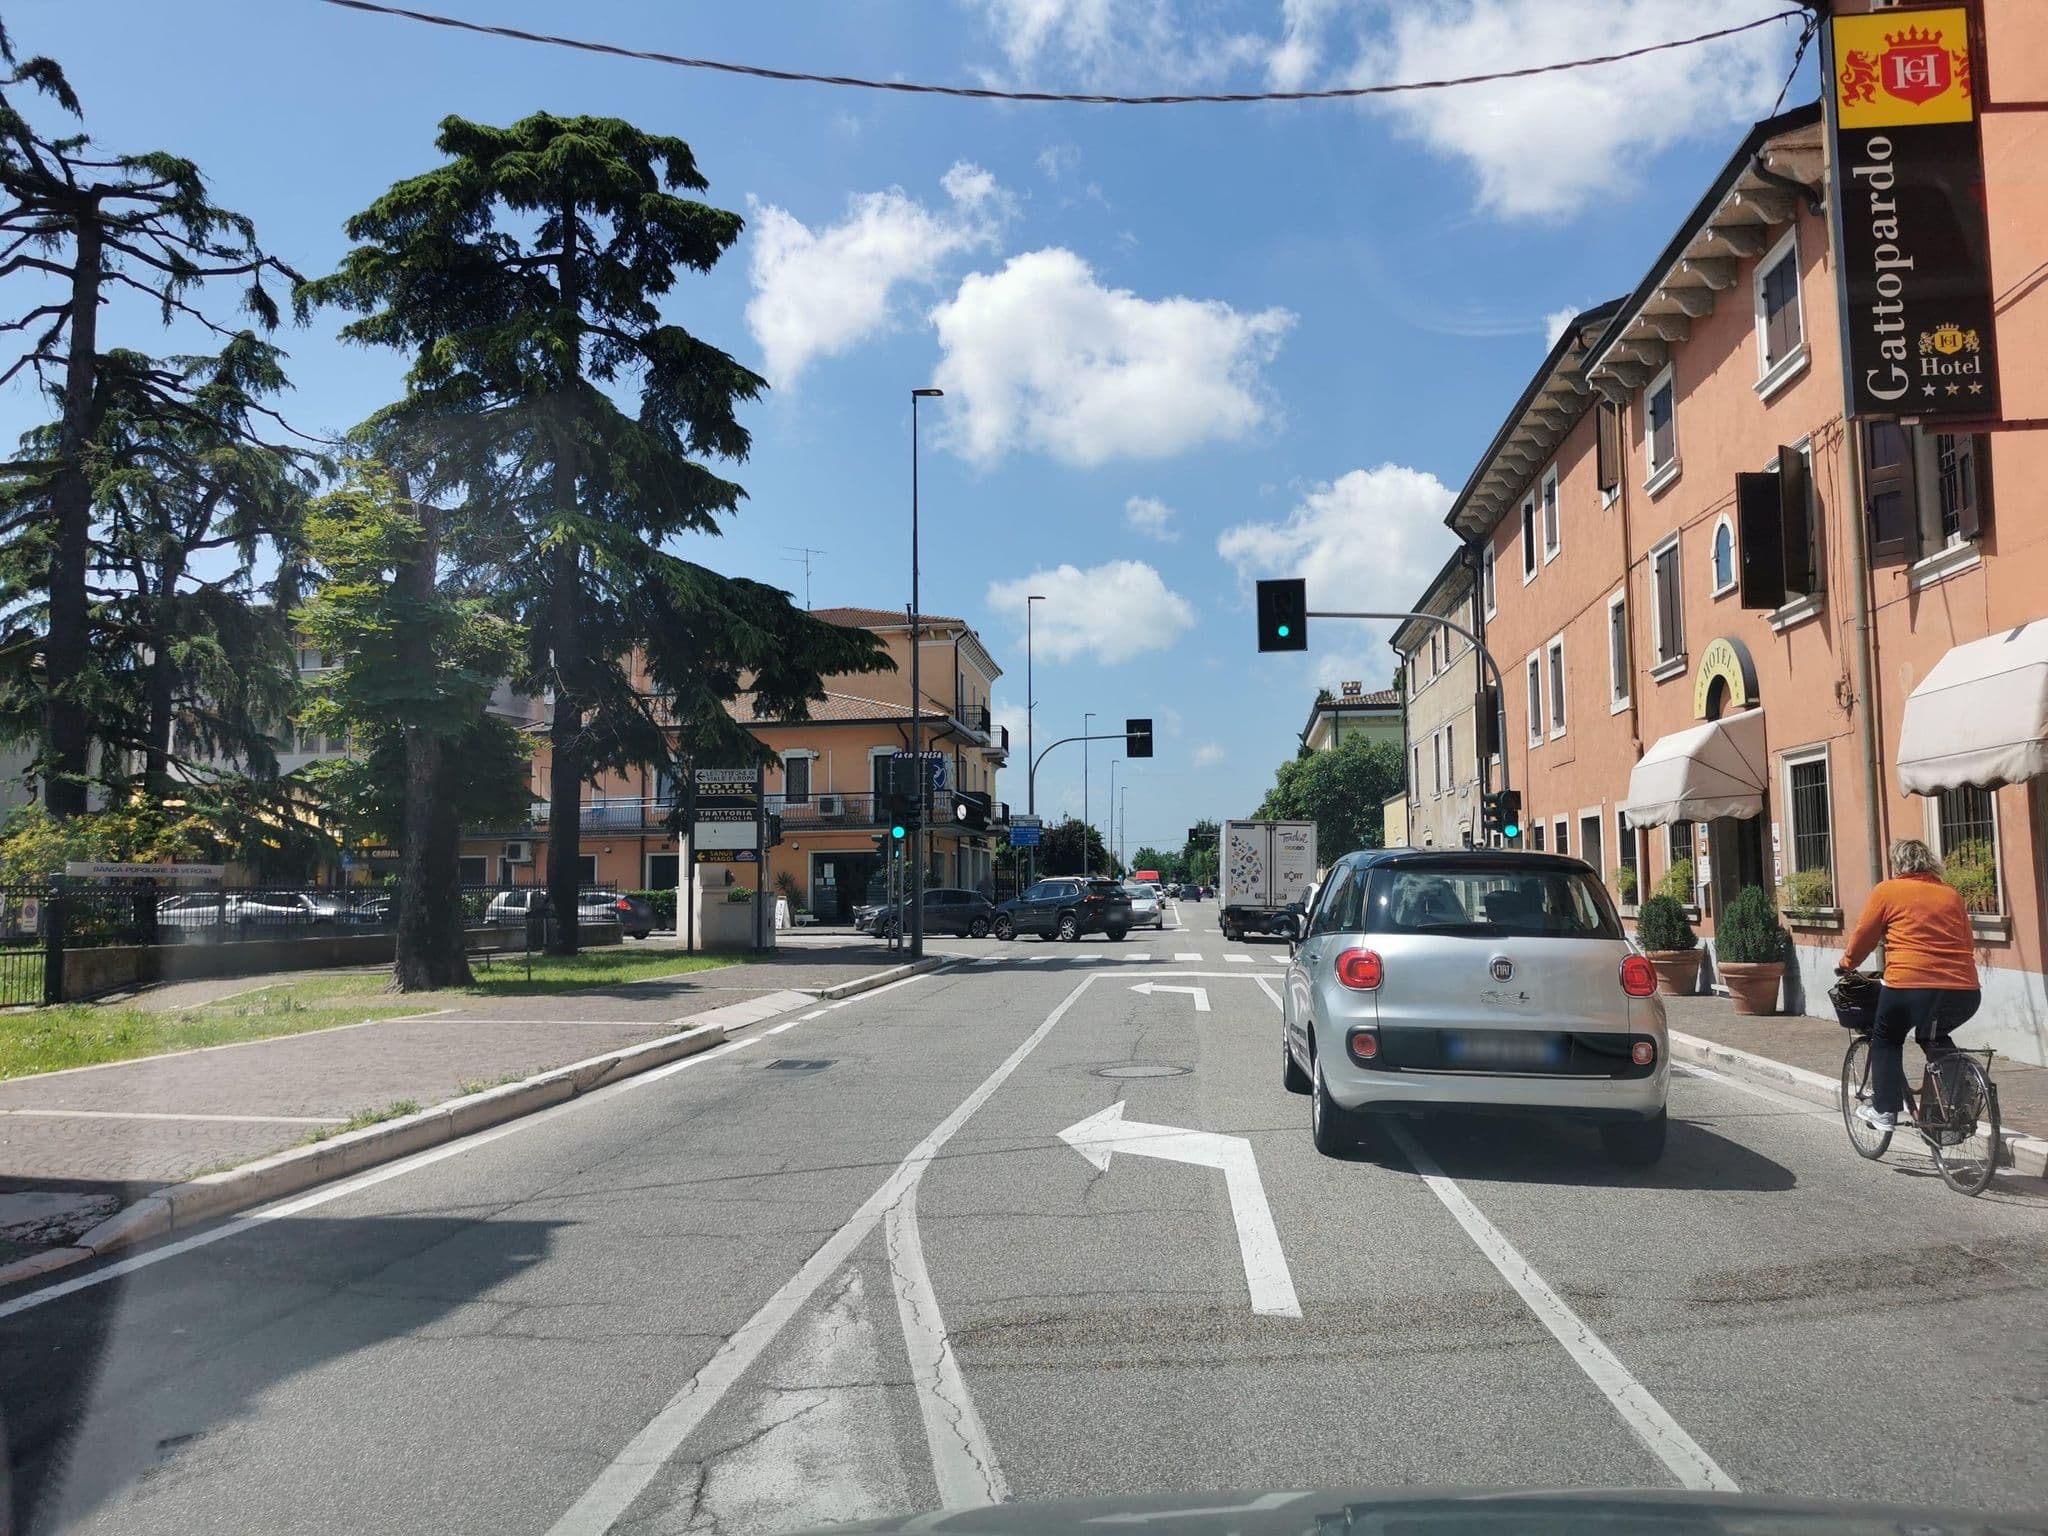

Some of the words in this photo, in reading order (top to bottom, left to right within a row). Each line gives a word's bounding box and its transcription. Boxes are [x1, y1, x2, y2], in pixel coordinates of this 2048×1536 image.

[1853, 136, 1914, 401] Gattopardo
[1920, 355, 1982, 376] Hotel
[1703, 646, 1732, 679] HOTEL
[125, 866, 167, 874] POPOLARE
[1496, 964, 1510, 976] FIAT
